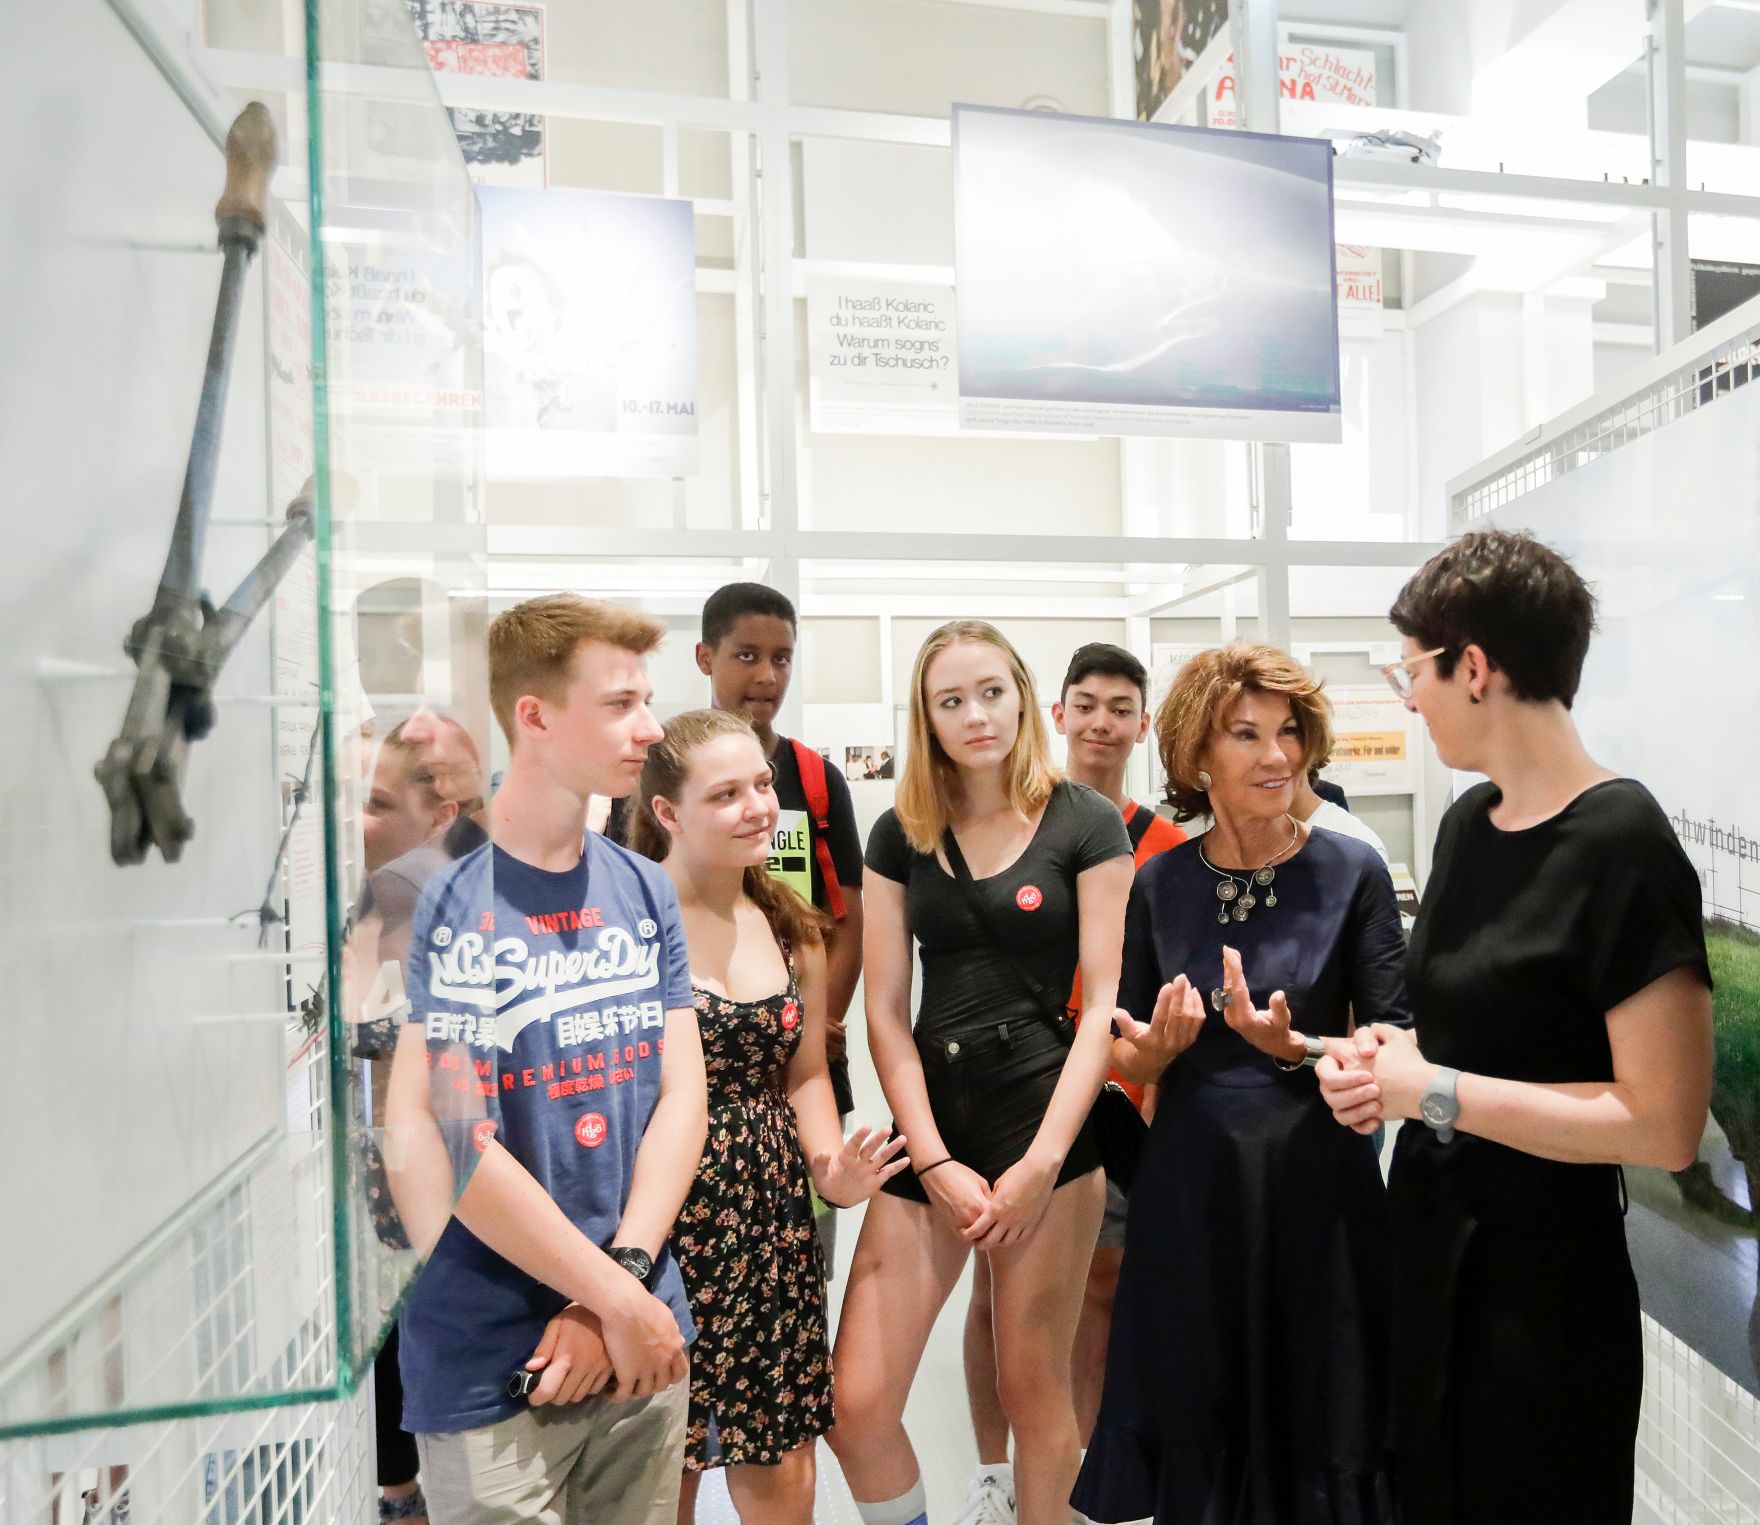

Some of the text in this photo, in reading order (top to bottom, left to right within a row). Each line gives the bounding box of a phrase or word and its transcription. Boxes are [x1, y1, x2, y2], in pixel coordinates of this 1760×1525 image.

[1346, 279, 1381, 304] ALLE!
[845, 297, 881, 312] haaß
[886, 298, 935, 314] Kolaric
[829, 313, 947, 332] du haaßt Kolaric
[837, 333, 890, 349] Warum
[829, 353, 950, 370] zu dir Tschusch?
[666, 401, 696, 416] MAI
[526, 907, 605, 936] VINTAGE
